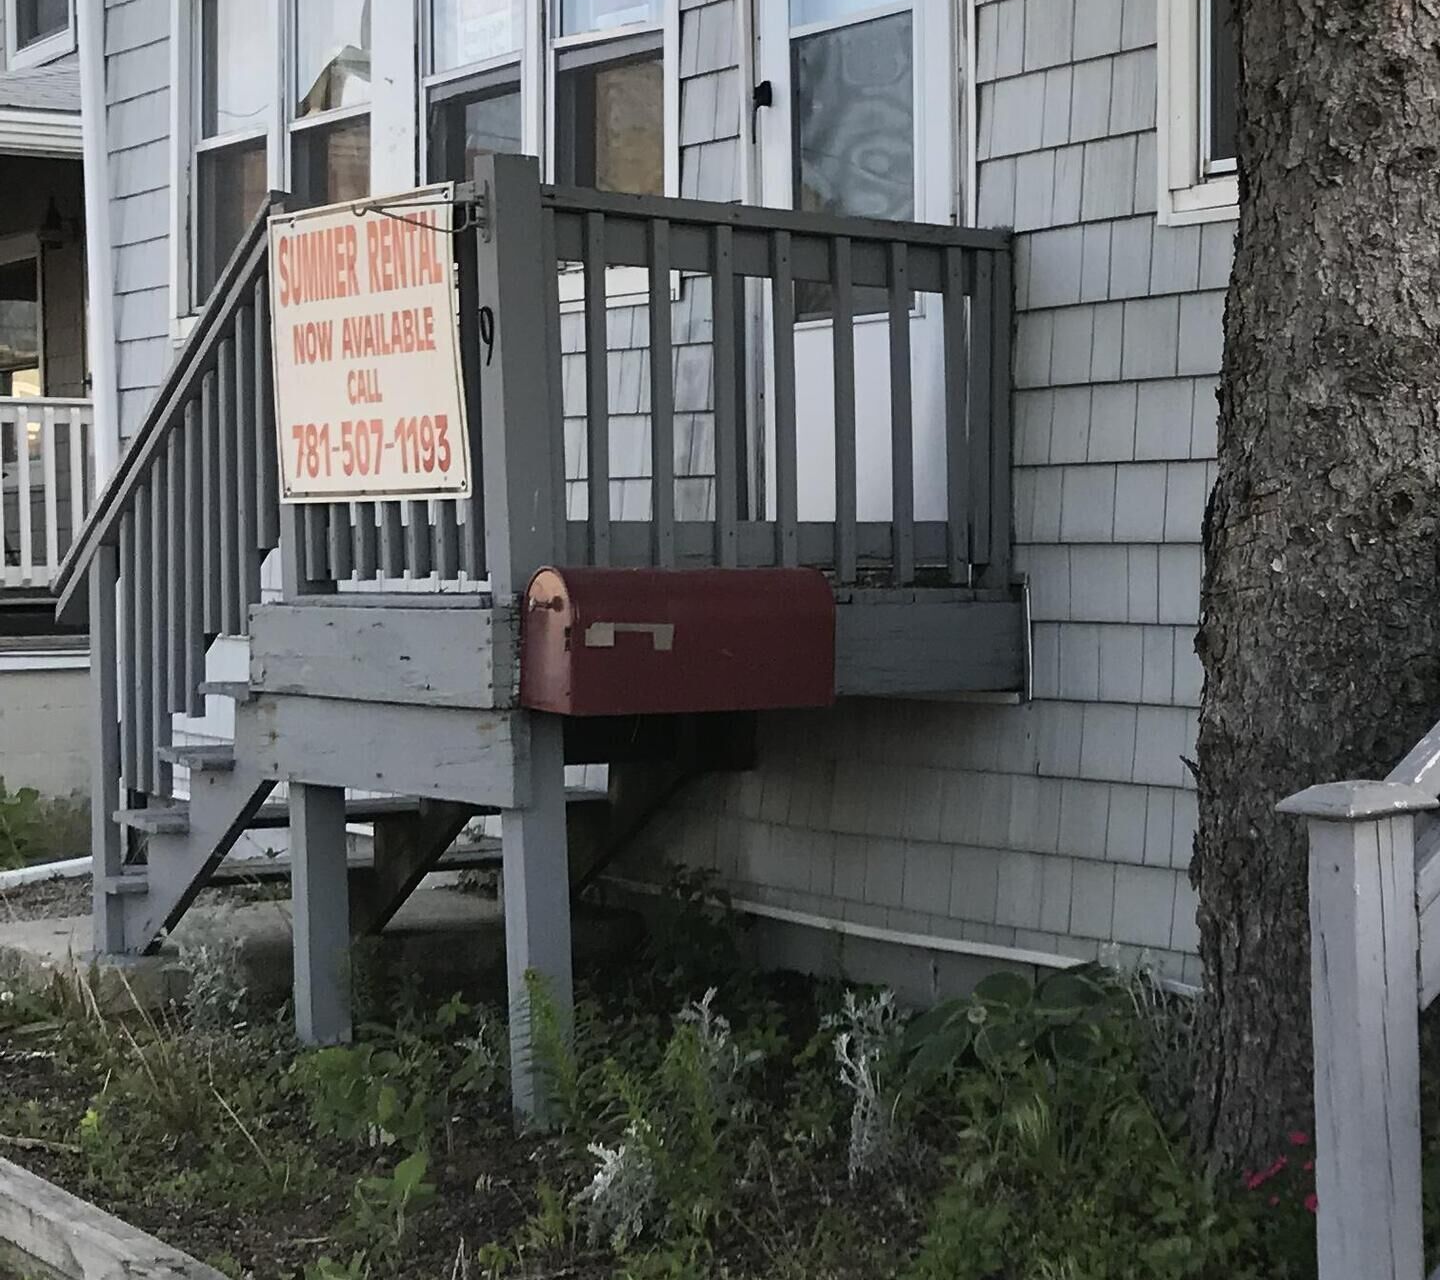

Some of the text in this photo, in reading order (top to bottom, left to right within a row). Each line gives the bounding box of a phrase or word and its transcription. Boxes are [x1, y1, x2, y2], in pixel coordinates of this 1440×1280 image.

[279, 209, 443, 308] SUMMER RENTAL
[292, 306, 437, 366] NOW AVAILABLE
[347, 368, 383, 405] CALL
[292, 414, 451, 479] 781-507-1193
